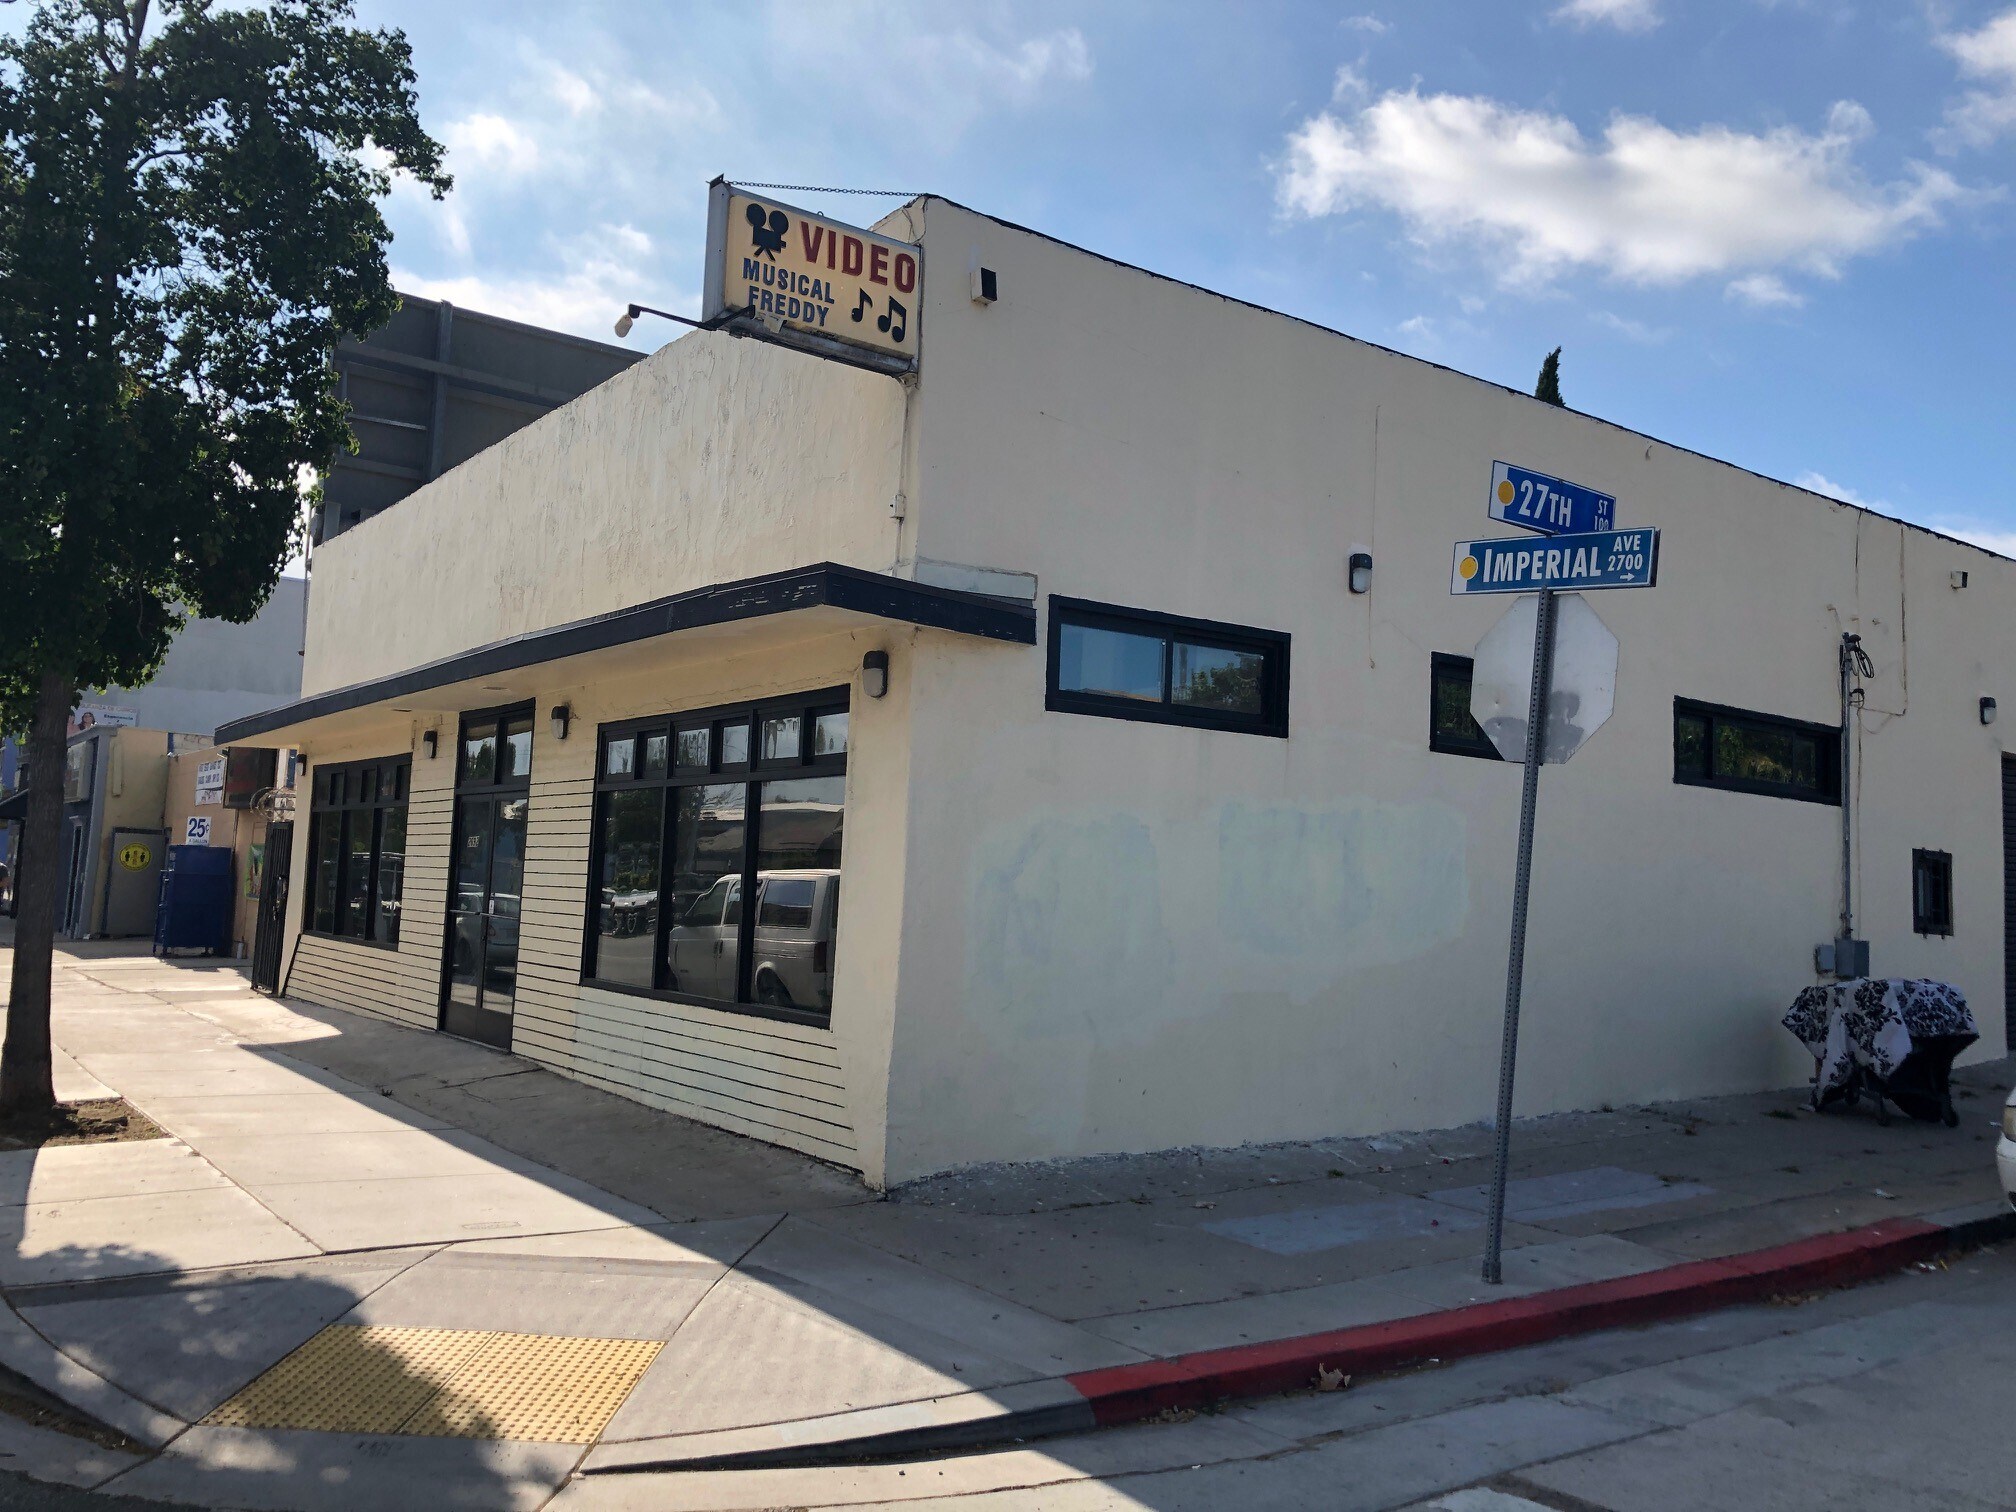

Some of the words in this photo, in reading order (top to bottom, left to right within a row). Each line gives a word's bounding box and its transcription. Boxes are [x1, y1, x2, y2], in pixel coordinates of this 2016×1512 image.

[742, 257, 835, 305] MUSICAL
[801, 221, 915, 293] VIDEO
[749, 285, 830, 327] FREDDY
[1518, 479, 1572, 527] 27TH
[1597, 499, 1608, 515] ST
[1482, 546, 1602, 583] IMPERIAL
[1613, 534, 1642, 552] AVE
[1607, 553, 1644, 571] 2700
